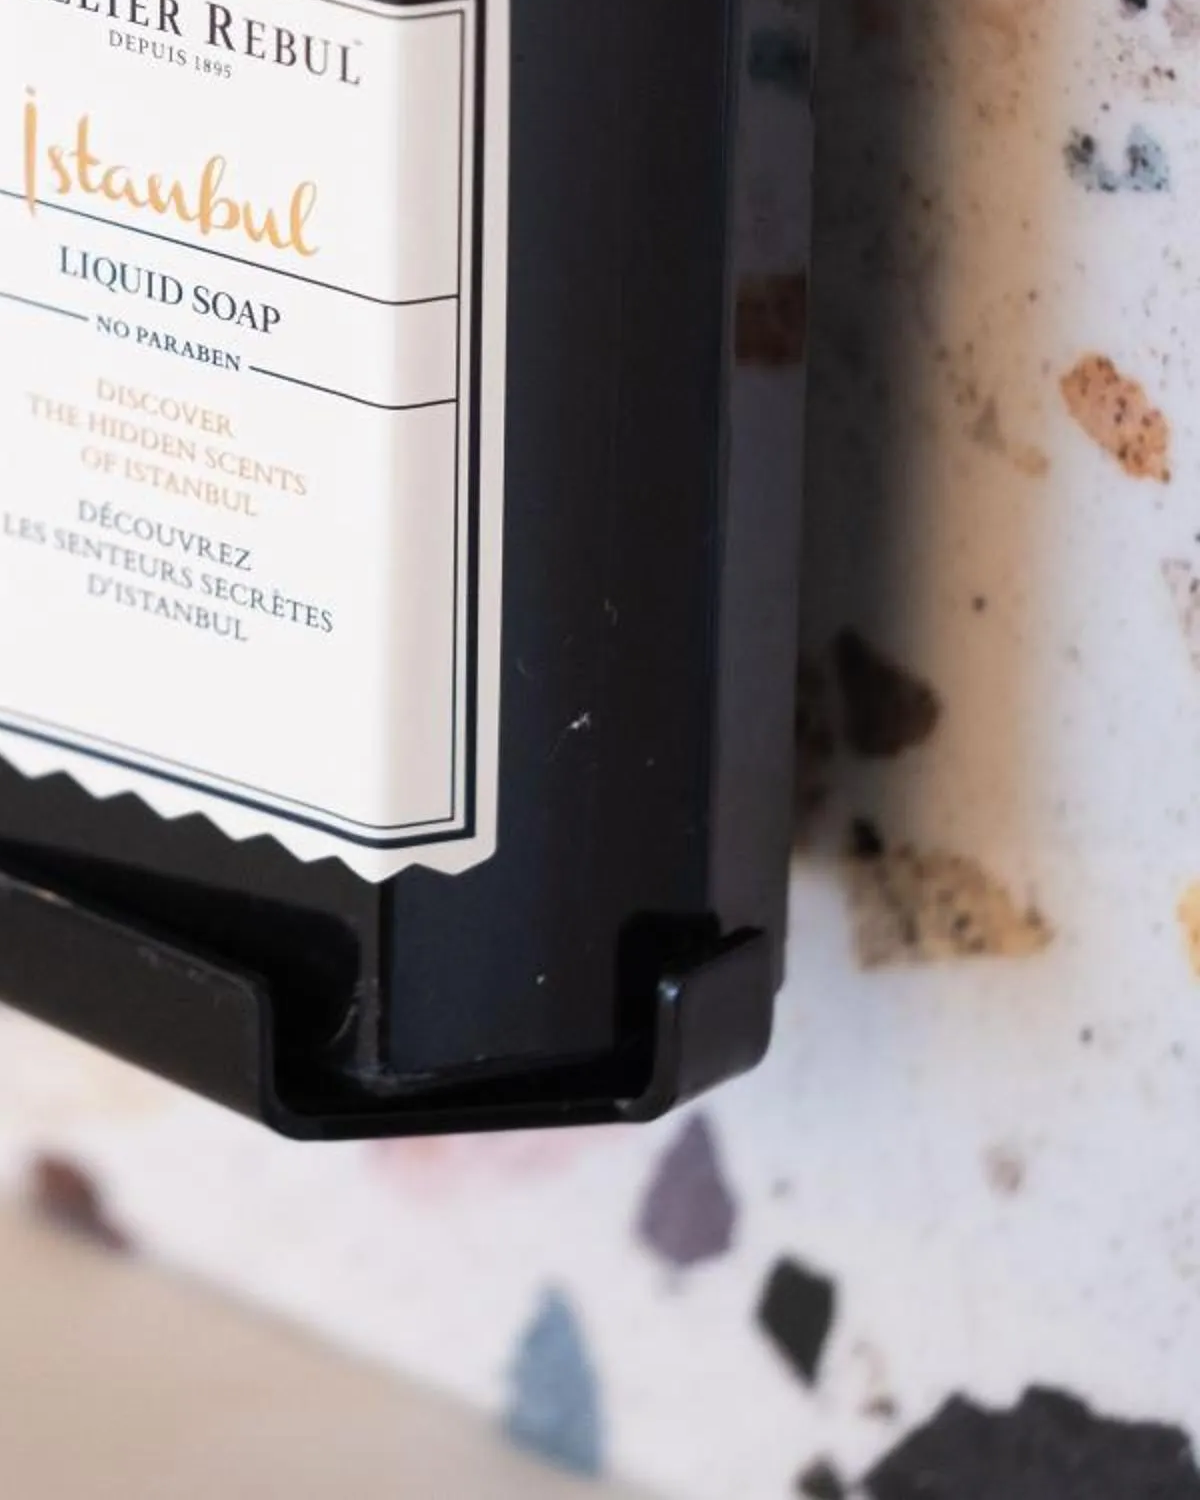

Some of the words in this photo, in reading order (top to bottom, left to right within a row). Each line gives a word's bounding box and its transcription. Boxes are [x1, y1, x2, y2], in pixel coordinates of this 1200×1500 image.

[108, 29, 188, 67] DEPUIS
[194, 55, 233, 80] 1895
[205, 0, 362, 86] REBUL
[59, 244, 184, 306] LIQUID
[191, 285, 282, 334] SOAP
[96, 315, 131, 339] NO
[135, 326, 242, 373] PARABEN
[96, 376, 237, 438] DISCOVER
[26, 391, 79, 428] THE
[88, 410, 197, 463] HIDDEN
[204, 445, 308, 497] SCENTS
[80, 444, 116, 473] OF
[124, 457, 259, 518] ISTANBUL
[78, 499, 253, 572] DÉCOUVREZ
[3, 512, 47, 546] LES
[53, 530, 194, 591] SENTEURS
[200, 572, 334, 633] SECRÈTES
[86, 572, 249, 642] D'ISTANBUL
